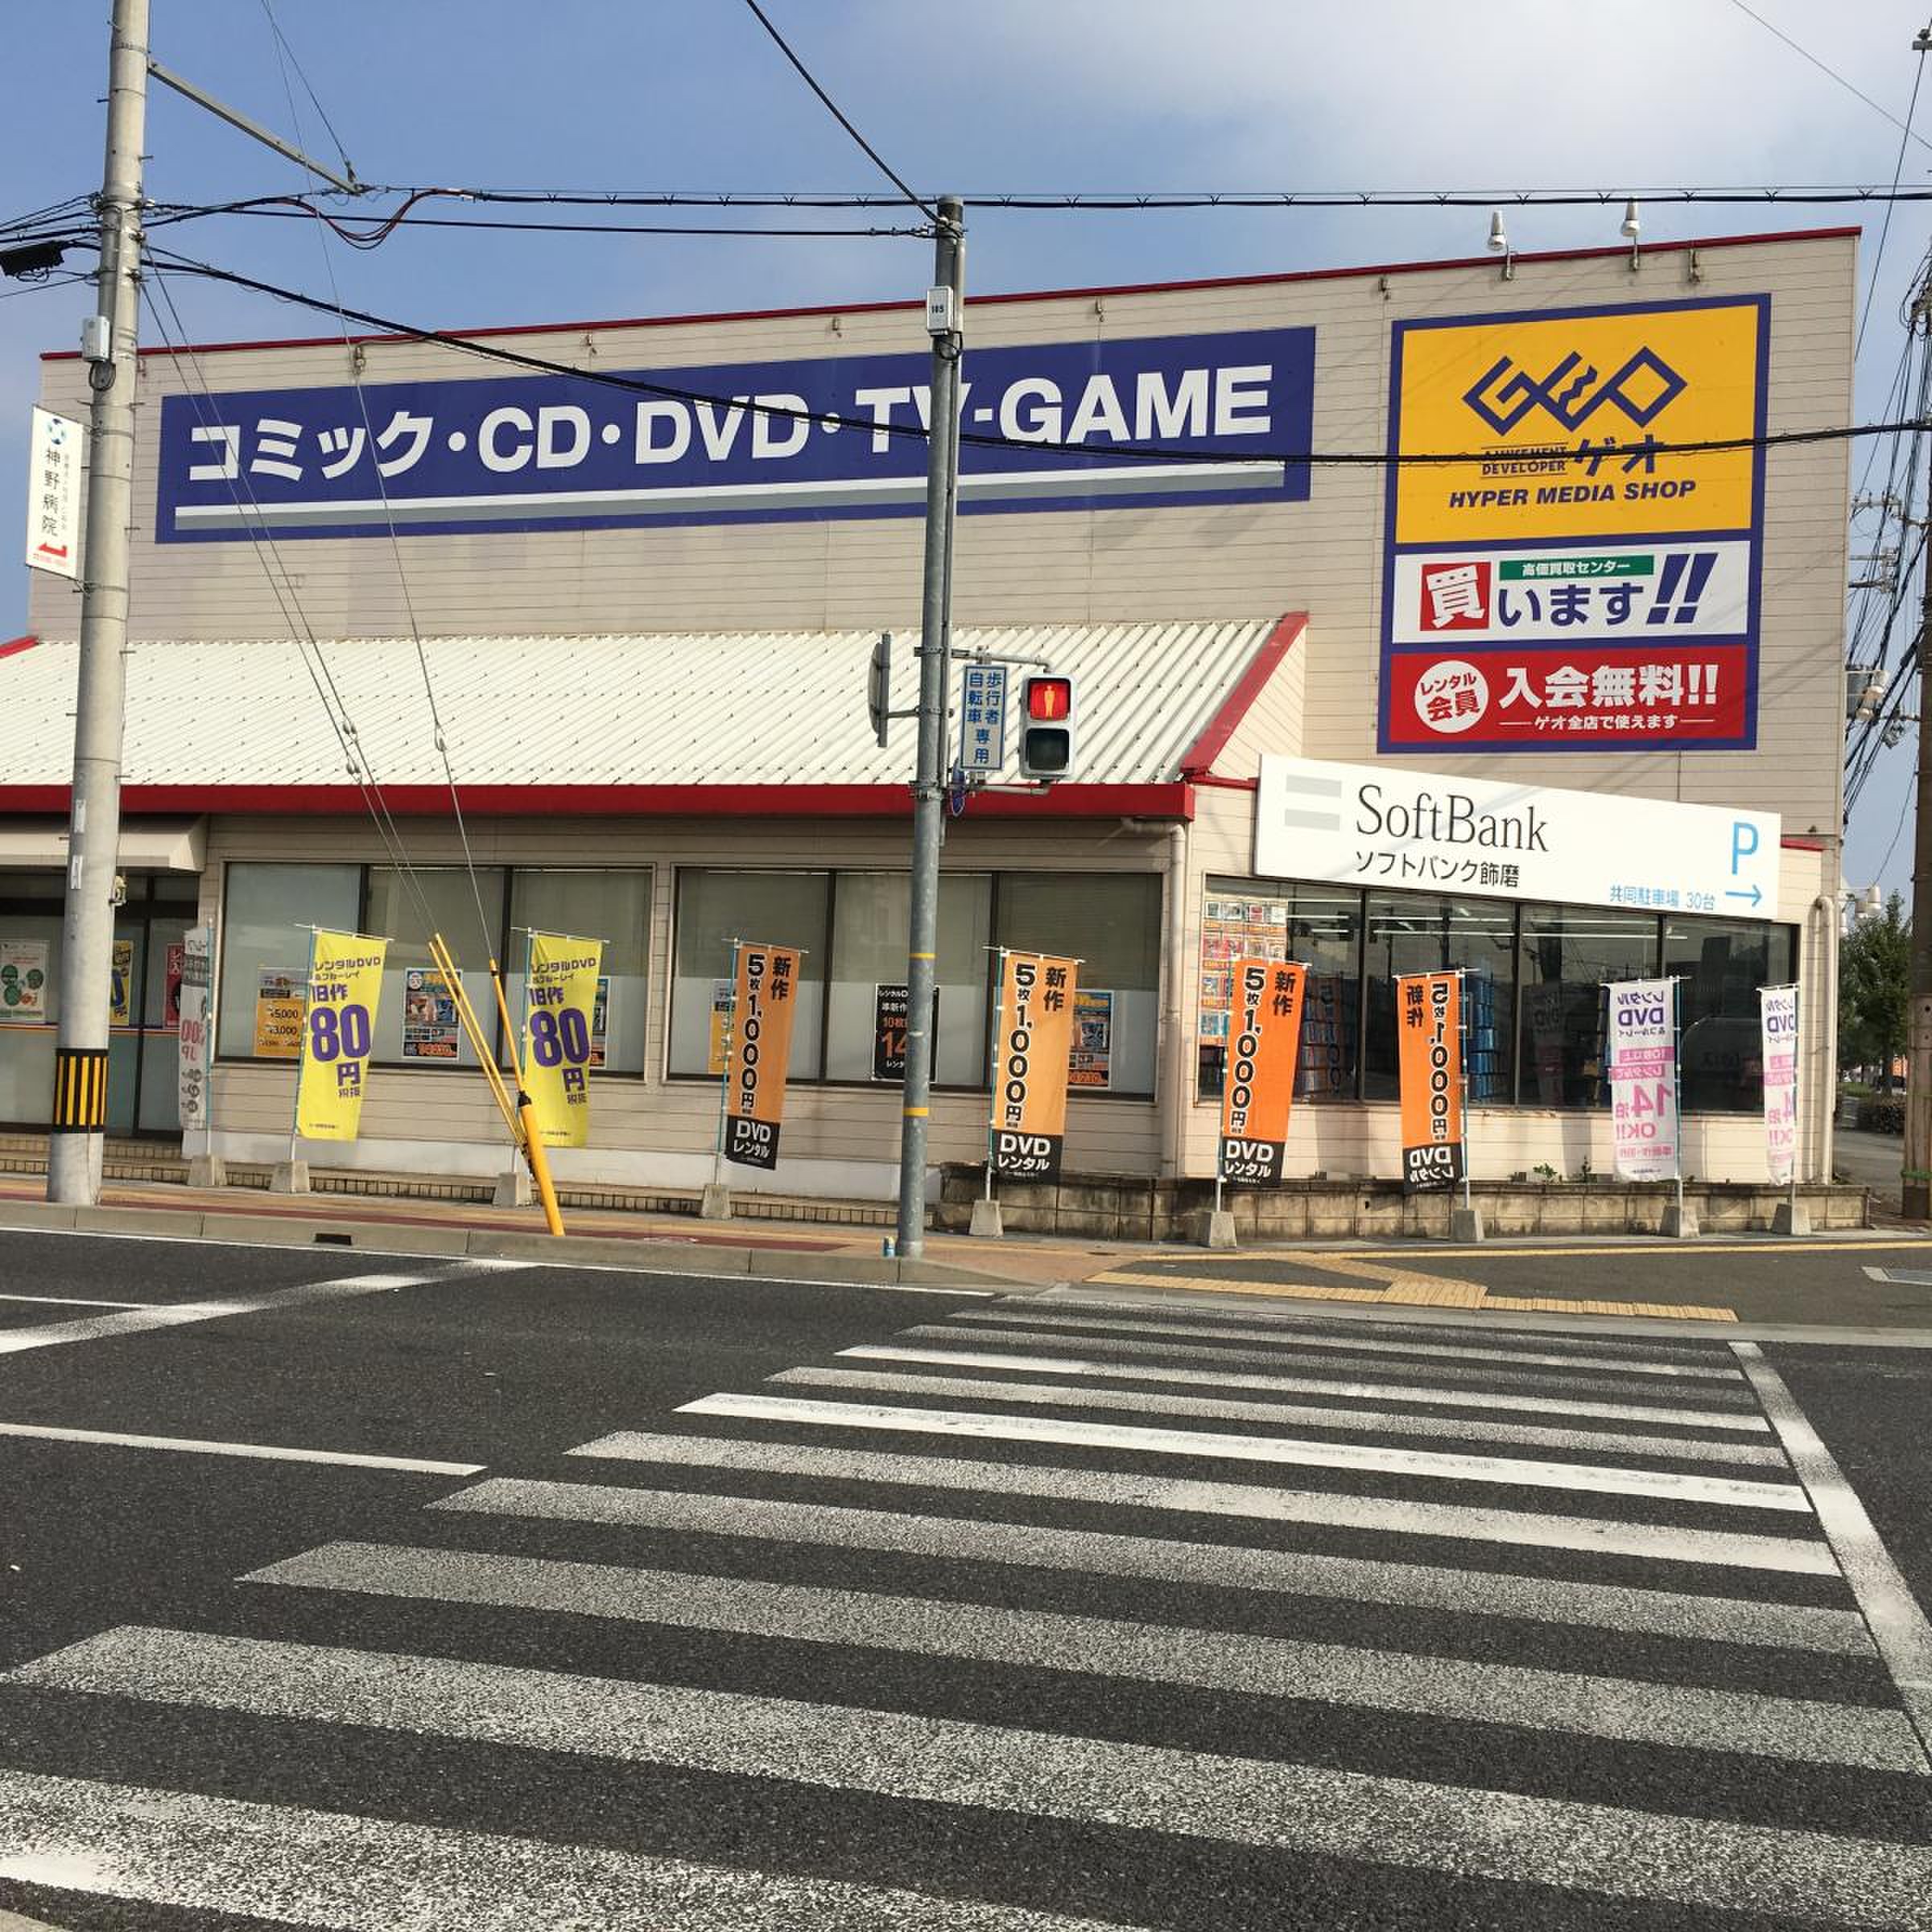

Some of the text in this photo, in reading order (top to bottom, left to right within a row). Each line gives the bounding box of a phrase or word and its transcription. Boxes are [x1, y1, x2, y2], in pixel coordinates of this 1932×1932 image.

[1482, 460, 1566, 475] DEVELOPER
[41, 447, 61, 537] 神野病院
[1449, 481, 1695, 508] HYPER MEDIA SHOP
[1521, 560, 1631, 577] 高価買取センター
[1420, 672, 1476, 696] レンタル
[1498, 664, 1719, 709] 入会無料!!
[968, 672, 984, 724] 自転車
[985, 671, 1001, 724] 歩行者
[1427, 689, 1480, 722] 会員
[1534, 714, 1678, 730] ゲオ全店で使えます
[974, 728, 990, 765] 専用
[1356, 784, 1550, 852] SoftBank
[1732, 821, 1759, 875] P
[1356, 851, 1520, 888] ソフトバンク飾磨
[1610, 885, 1715, 911] 共同駐車場 30台
[315, 956, 381, 972] レンタルDVD
[770, 956, 791, 1001] 新作
[1043, 967, 1067, 1012] 新作
[312, 984, 348, 1003] 旧作
[530, 986, 564, 1006] 旧作
[1272, 971, 1296, 1018] 新作
[310, 1004, 371, 1063] 80
[529, 1008, 591, 1067] 80
[336, 1061, 361, 1087] 円
[562, 1067, 585, 1092] 円
[736, 1120, 771, 1143] DVD
[733, 1139, 770, 1158] レンタル
[1000, 1134, 1051, 1156] DVD
[1225, 1141, 1274, 1162] DVD
[997, 1154, 1050, 1170] レンタル
[1224, 1159, 1272, 1178] レンタル
